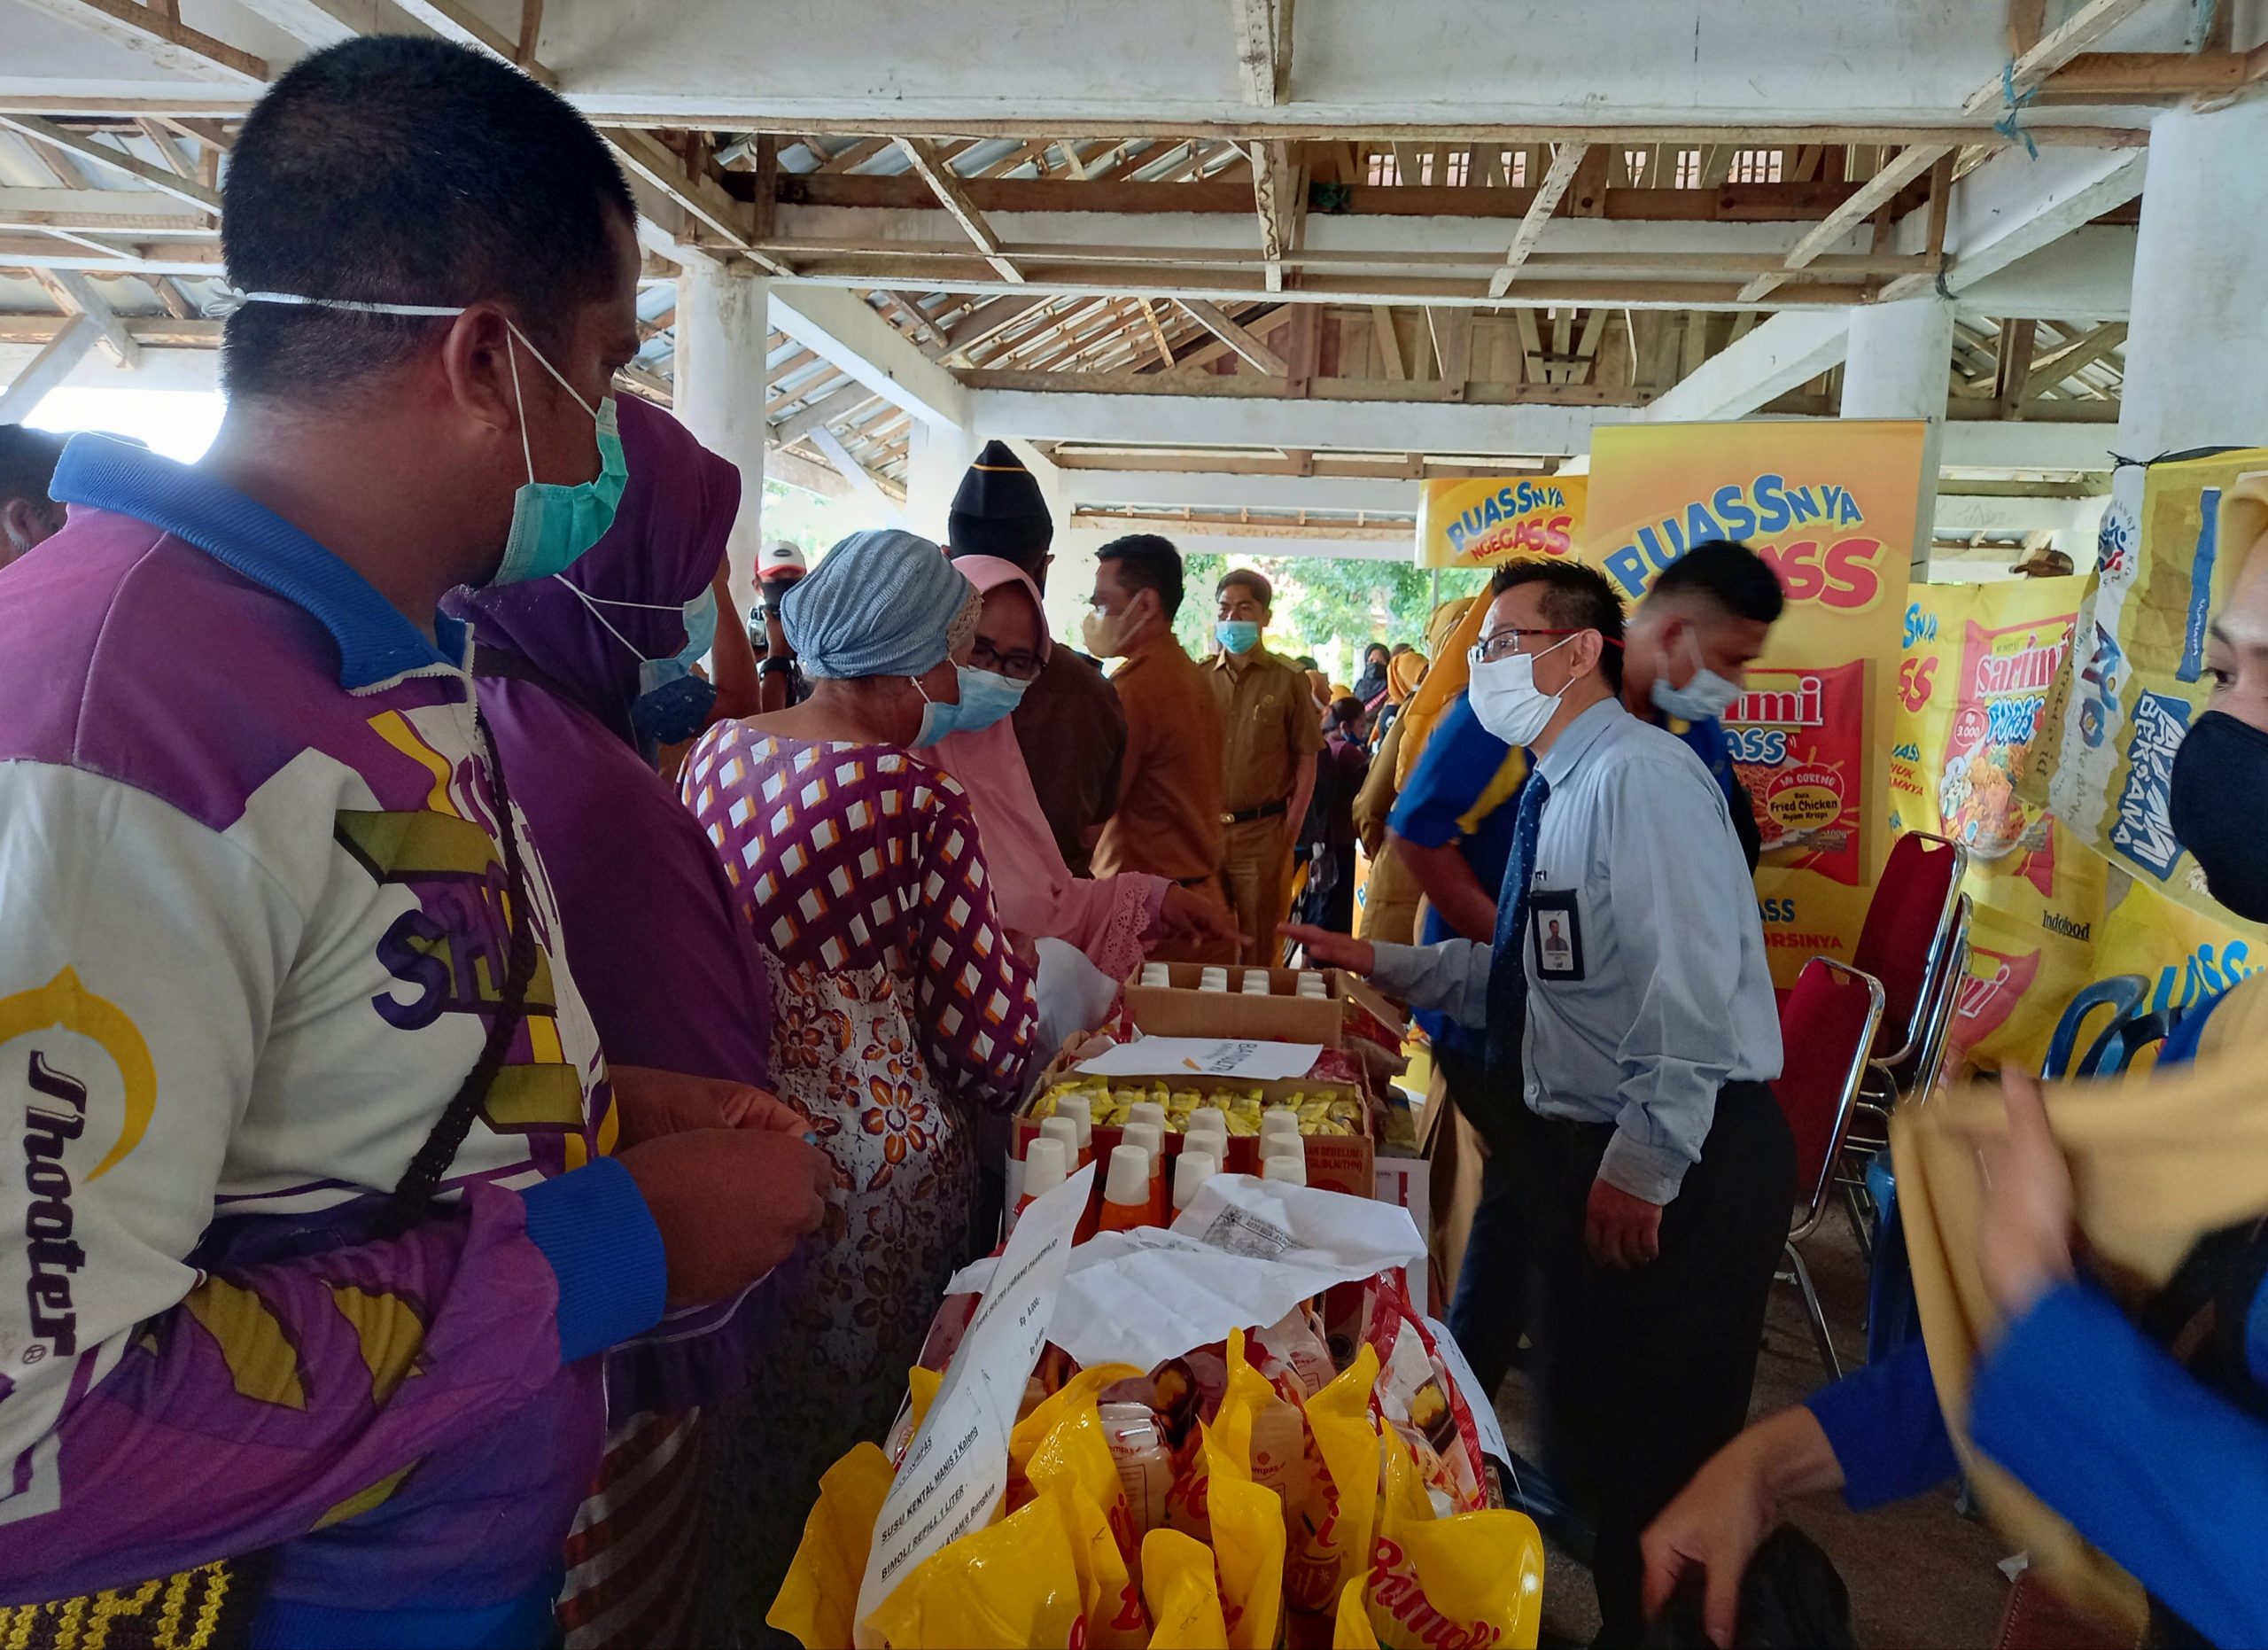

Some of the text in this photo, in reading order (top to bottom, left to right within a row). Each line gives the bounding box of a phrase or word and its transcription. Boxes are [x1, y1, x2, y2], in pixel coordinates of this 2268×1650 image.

[1446, 481, 1565, 553] PUASSNYA
[1471, 516, 1573, 561] NGEGASS
[1604, 474, 1863, 598] PUASSNYA
[1902, 603, 1938, 650] SNYA
[1724, 728, 1788, 764] ASS
[1956, 724, 1980, 737] 3.000
[2114, 696, 2155, 845] BERSAMA
[1770, 798, 1838, 812] Fried Chicken
[1782, 813, 1804, 822] Ayam
[2042, 910, 2090, 942] Indofood
[23, 1049, 88, 1358] Shooter
[882, 1513, 906, 1544] SUSU
[906, 1482, 936, 1518] KENTAL
[935, 1455, 955, 1485] MANIS
[953, 1449, 960, 1460] 2
[958, 1426, 979, 1454] Kaleng
[882, 1542, 912, 1580] BIMOLI
[913, 1514, 939, 1546] REFILL
[944, 1483, 965, 1515] LITER
[944, 1519, 967, 1548] AYAM
[970, 1483, 996, 1518] Bungkus
